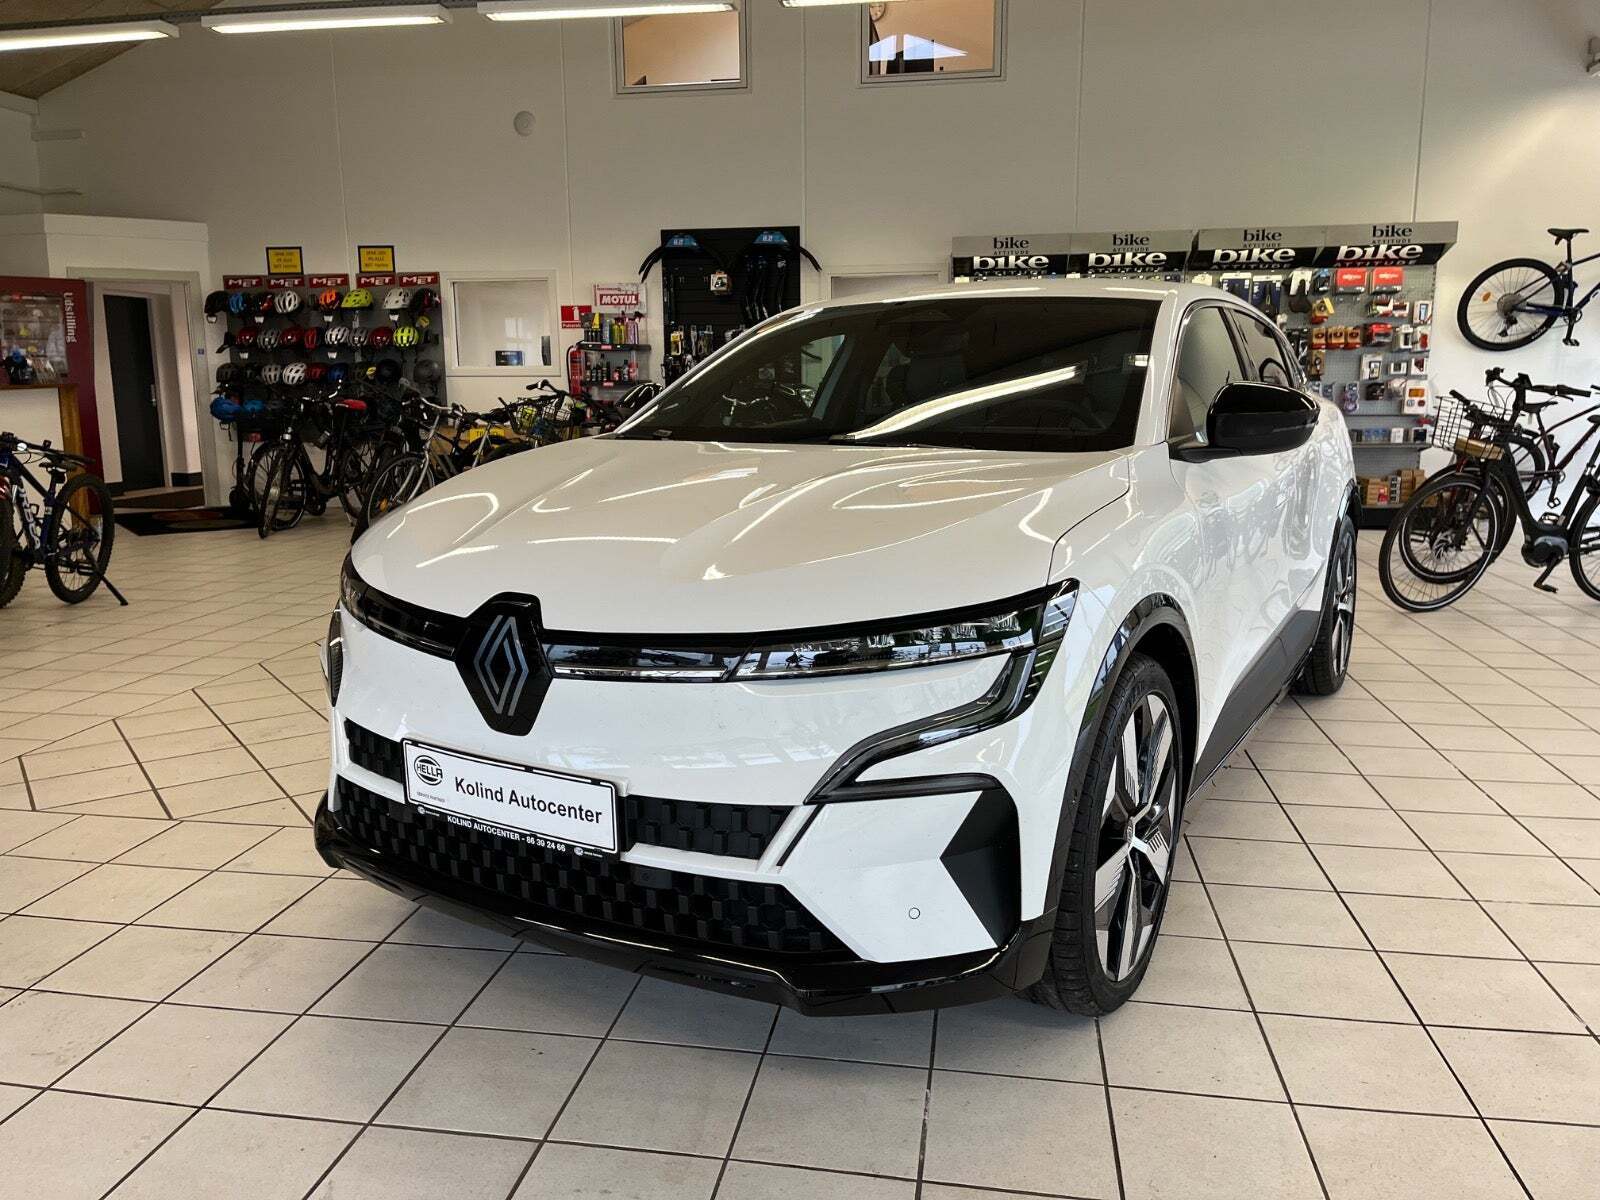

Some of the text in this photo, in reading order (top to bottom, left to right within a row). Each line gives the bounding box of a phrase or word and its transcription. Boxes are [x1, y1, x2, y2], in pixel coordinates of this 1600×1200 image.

[1243, 228, 1282, 242] bike
[1372, 224, 1412, 238] bike
[993, 236, 1030, 249] bike
[1112, 233, 1150, 246] bike
[1087, 252, 1167, 267] bike
[1212, 248, 1296, 264] bike
[1336, 244, 1423, 261] bike
[973, 255, 1049, 270] bike
[228, 279, 260, 288] MET
[270, 278, 302, 287] MET
[312, 278, 344, 286] MET
[360, 276, 392, 286] MET
[402, 276, 434, 285] MET
[601, 294, 637, 305] MOTUL
[63, 292, 77, 343] Udstilling
[416, 763, 443, 779] HELLA
[454, 776, 602, 824] Kolind Autocenter
[447, 815, 472, 828] KOLIND
[473, 820, 520, 841] AUTOCENTER
[536, 839, 545, 847] 39
[546, 841, 555, 850] 24
